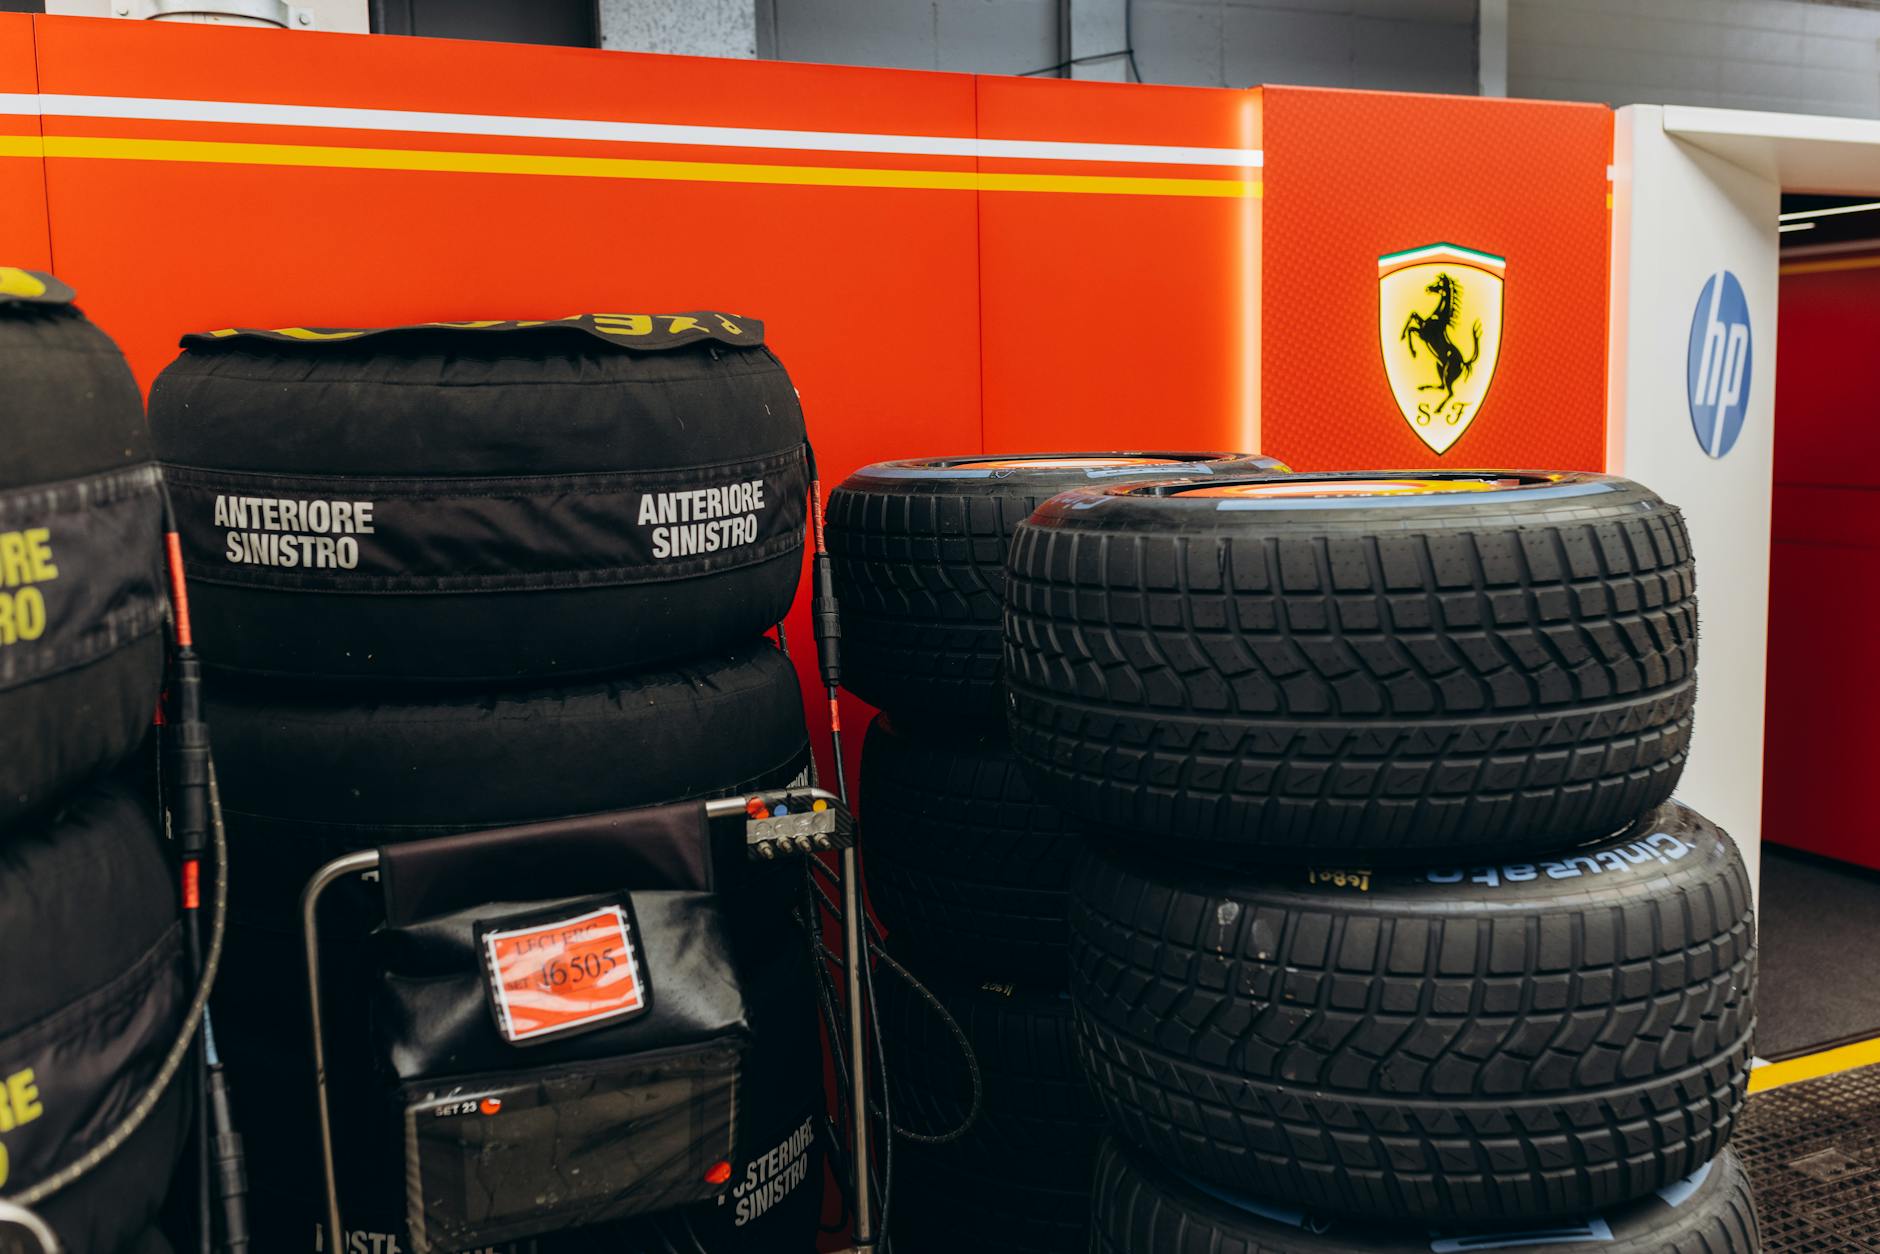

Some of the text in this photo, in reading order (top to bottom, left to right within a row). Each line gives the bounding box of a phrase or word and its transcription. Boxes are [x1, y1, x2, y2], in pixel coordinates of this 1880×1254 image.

[1695, 271, 1749, 458] hp
[1415, 402, 1432, 427] S
[214, 494, 374, 534] ANTERIORE
[638, 479, 765, 525] ANTERIORE
[226, 531, 359, 568] SINISTRO
[652, 513, 758, 559] SINISTRO
[541, 948, 618, 988] 16505
[435, 1101, 478, 1117] SET 23
[735, 1151, 808, 1227] SINISTRO
